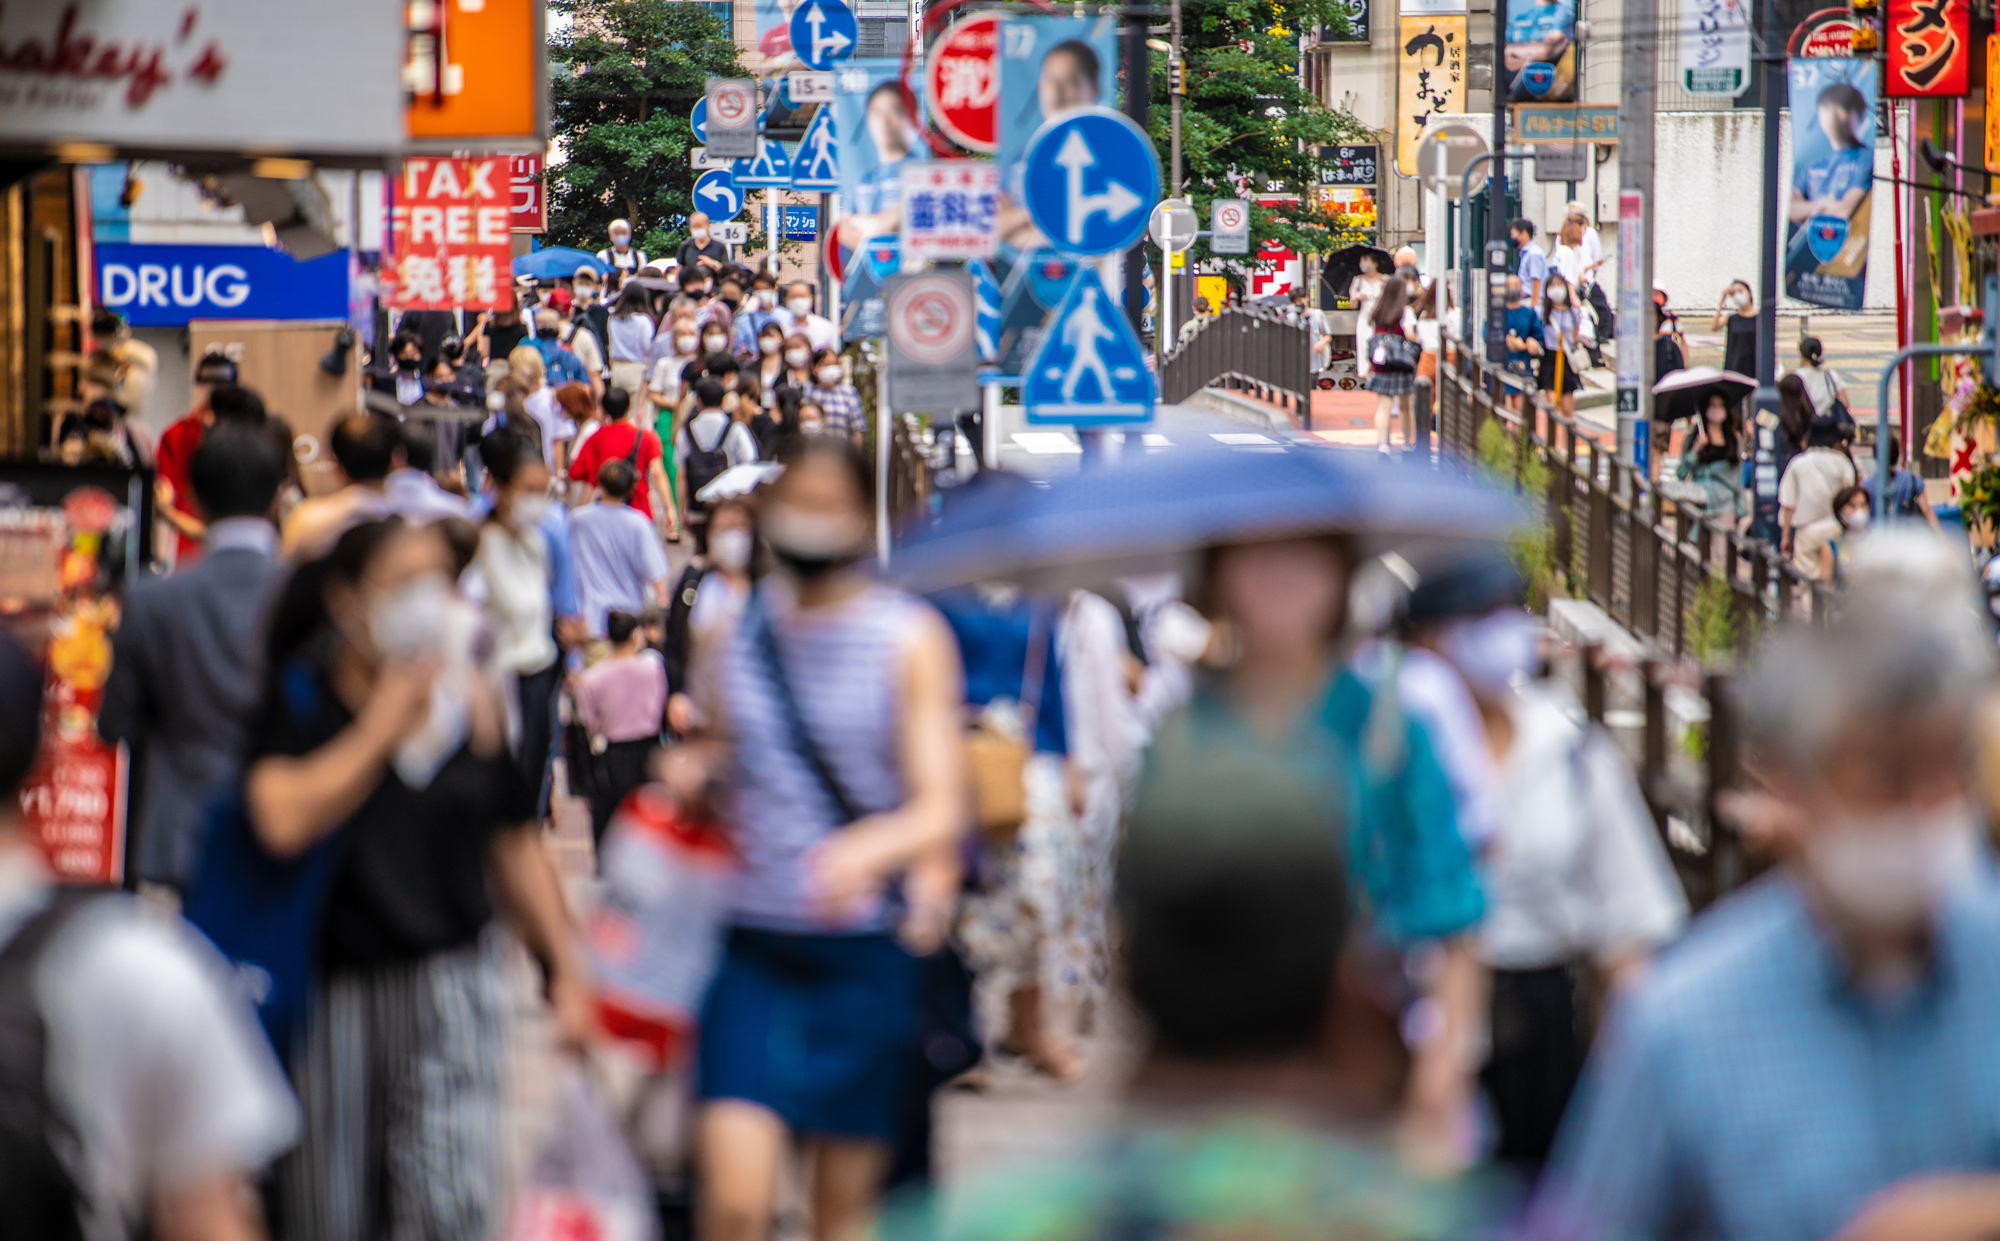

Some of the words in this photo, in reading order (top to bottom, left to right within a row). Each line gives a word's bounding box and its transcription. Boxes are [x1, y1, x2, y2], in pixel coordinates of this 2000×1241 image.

[0, 2, 227, 110] akey's
[1340, 147, 1355, 158] 6F
[406, 160, 495, 199] TAX
[1267, 180, 1284, 192] 3F
[102, 264, 250, 307] DRUG
[397, 254, 496, 304] 免税
